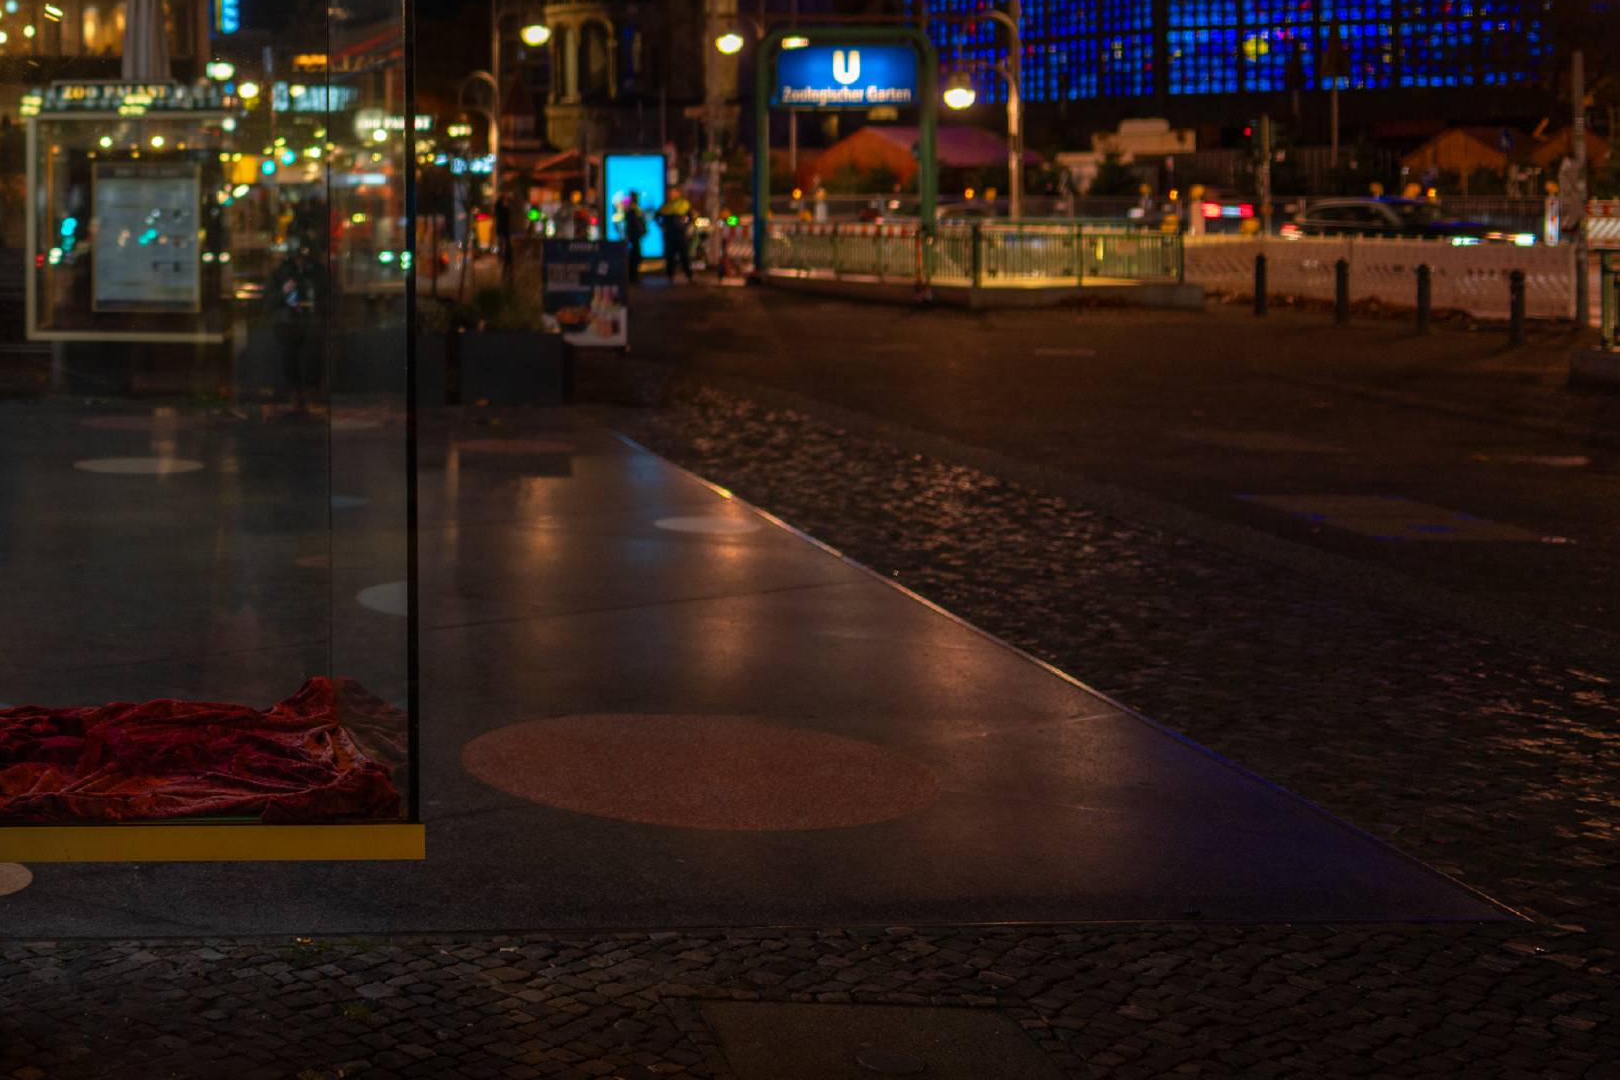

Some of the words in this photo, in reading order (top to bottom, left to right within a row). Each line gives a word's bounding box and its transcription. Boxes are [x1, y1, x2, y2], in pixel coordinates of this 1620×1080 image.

[832, 49, 861, 85] U
[783, 86, 863, 106] Zoologischer
[866, 85, 911, 102] Garten
